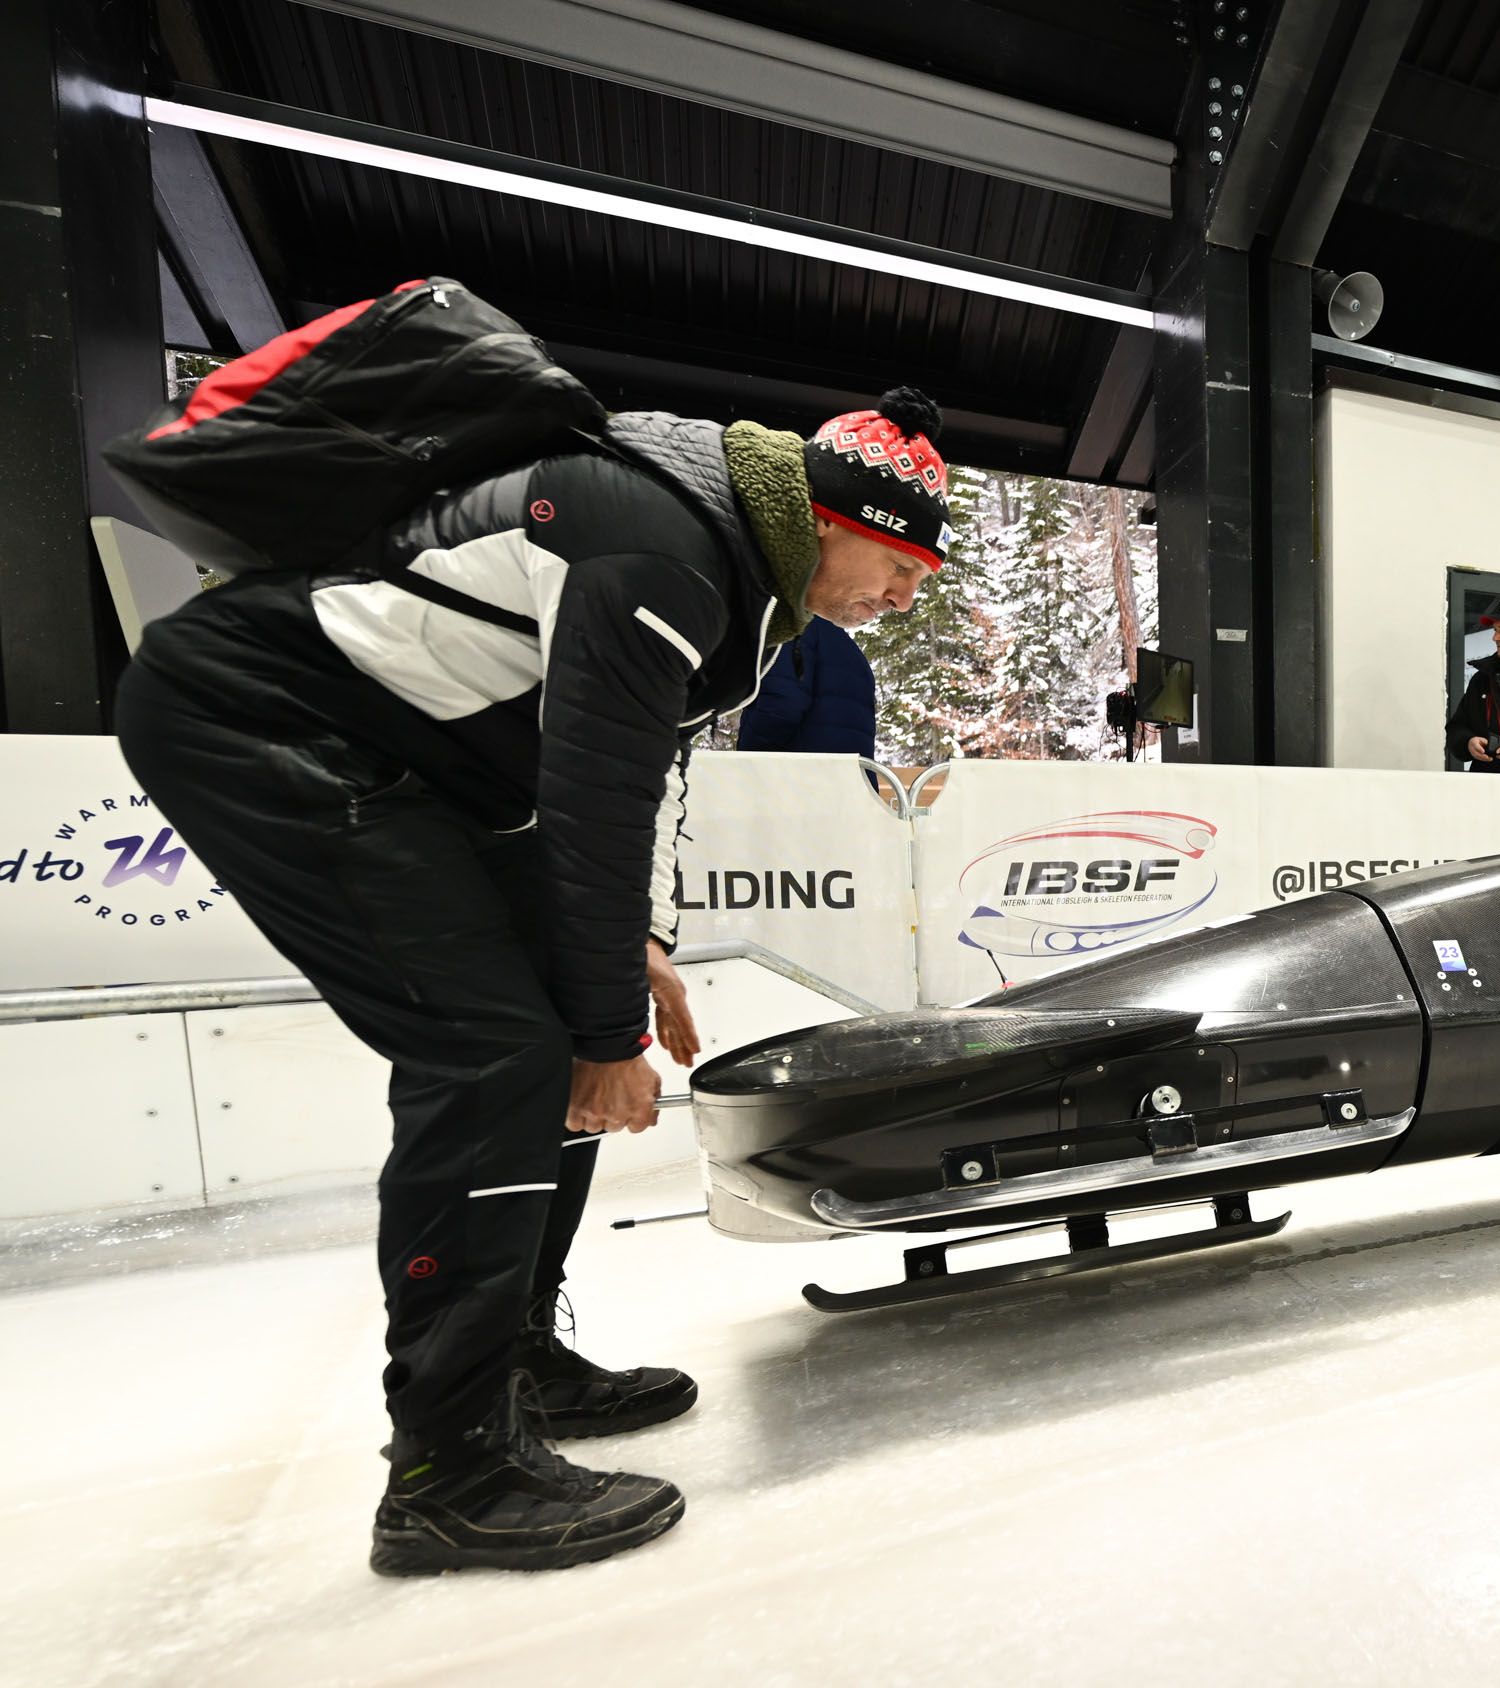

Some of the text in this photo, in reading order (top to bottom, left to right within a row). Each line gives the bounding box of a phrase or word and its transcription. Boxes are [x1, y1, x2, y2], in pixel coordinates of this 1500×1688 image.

[860, 505, 909, 533] SEIZ
[55, 795, 150, 840] WARM
[32, 851, 84, 882] to
[1003, 859, 1180, 896] IBSF
[74, 878, 229, 926] PROGRAM
[675, 870, 855, 909] LIDING
[1001, 898, 1054, 907] INTERNATIONAL
[1100, 895, 1132, 903] SKELETON
[1133, 894, 1173, 902] FEDERATION
[1440, 946, 1459, 958] 23
